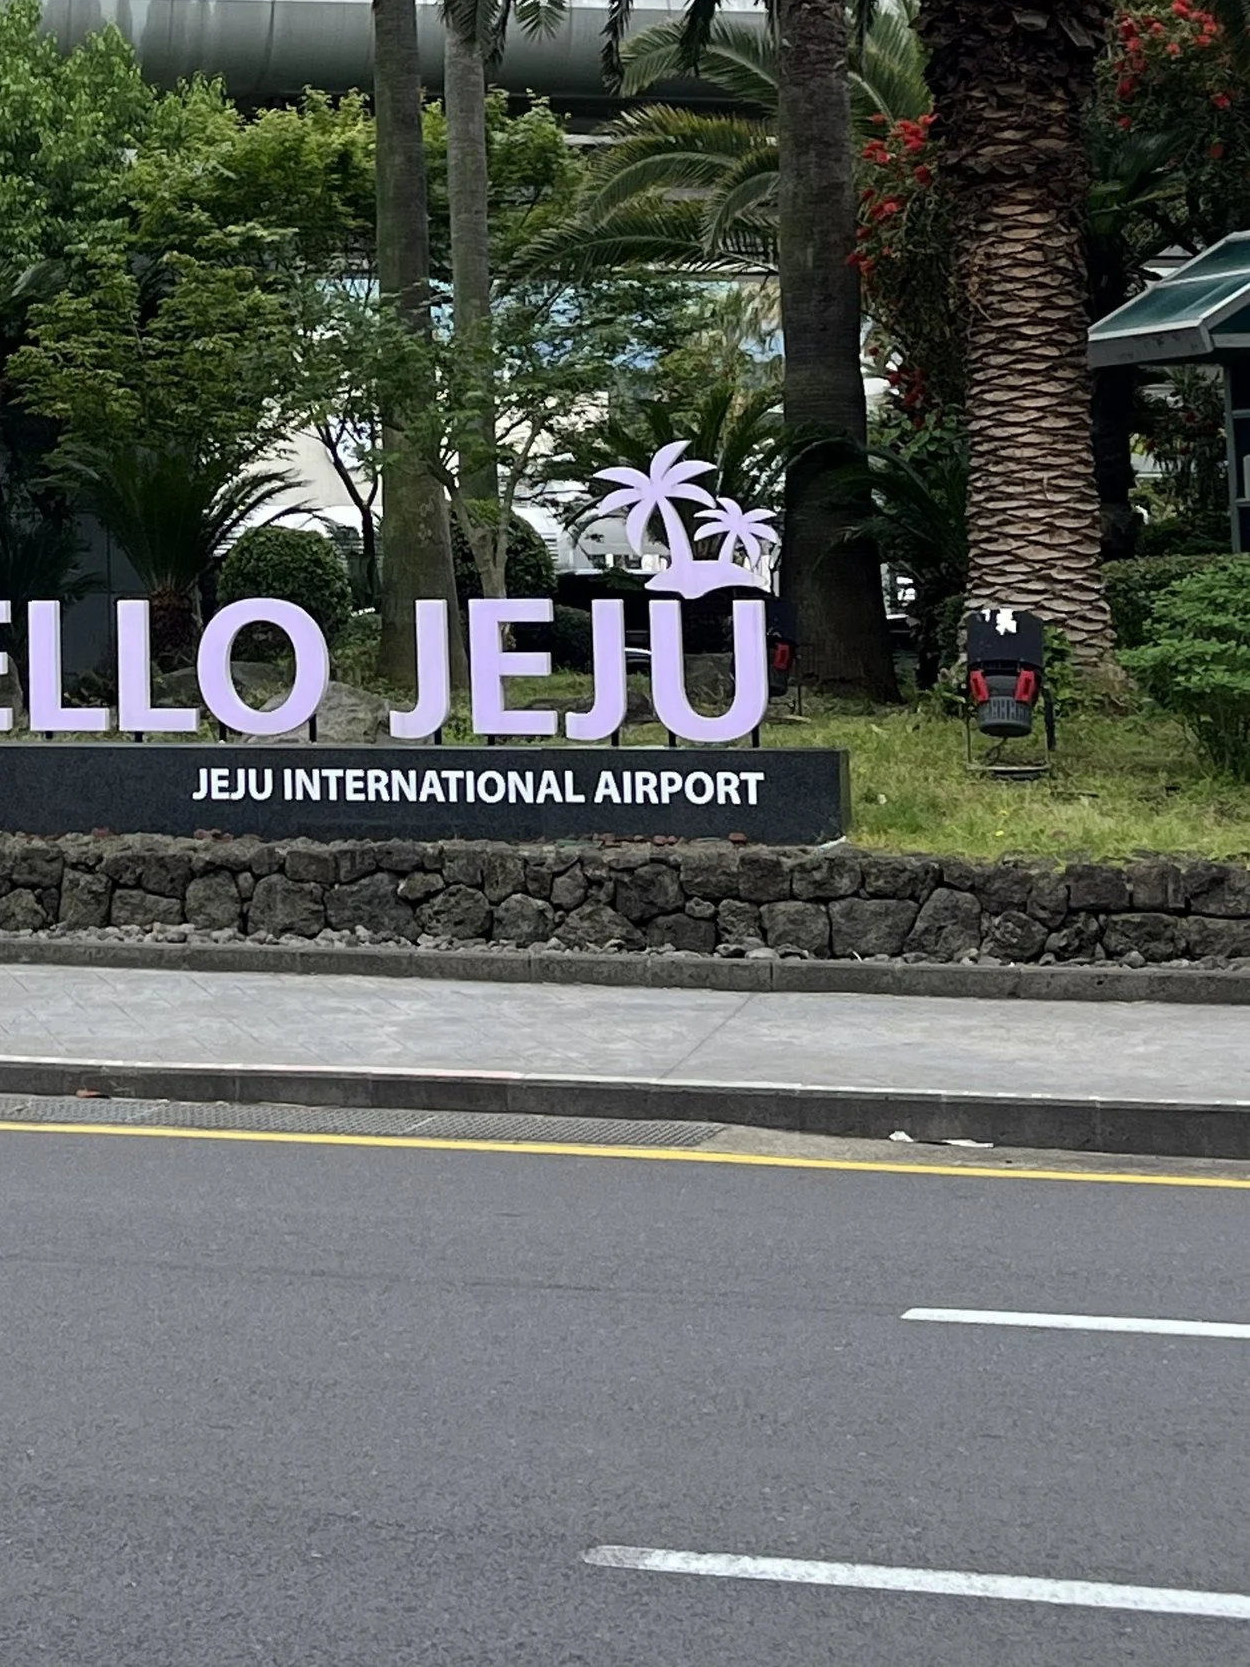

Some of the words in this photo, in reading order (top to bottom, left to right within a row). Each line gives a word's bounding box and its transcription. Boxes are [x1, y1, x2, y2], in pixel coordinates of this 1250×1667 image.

[389, 599, 768, 742] JEJU
[192, 768, 273, 801] JEJU
[283, 768, 586, 804] INTERNATIONAL
[593, 770, 766, 805] AIRPORT
